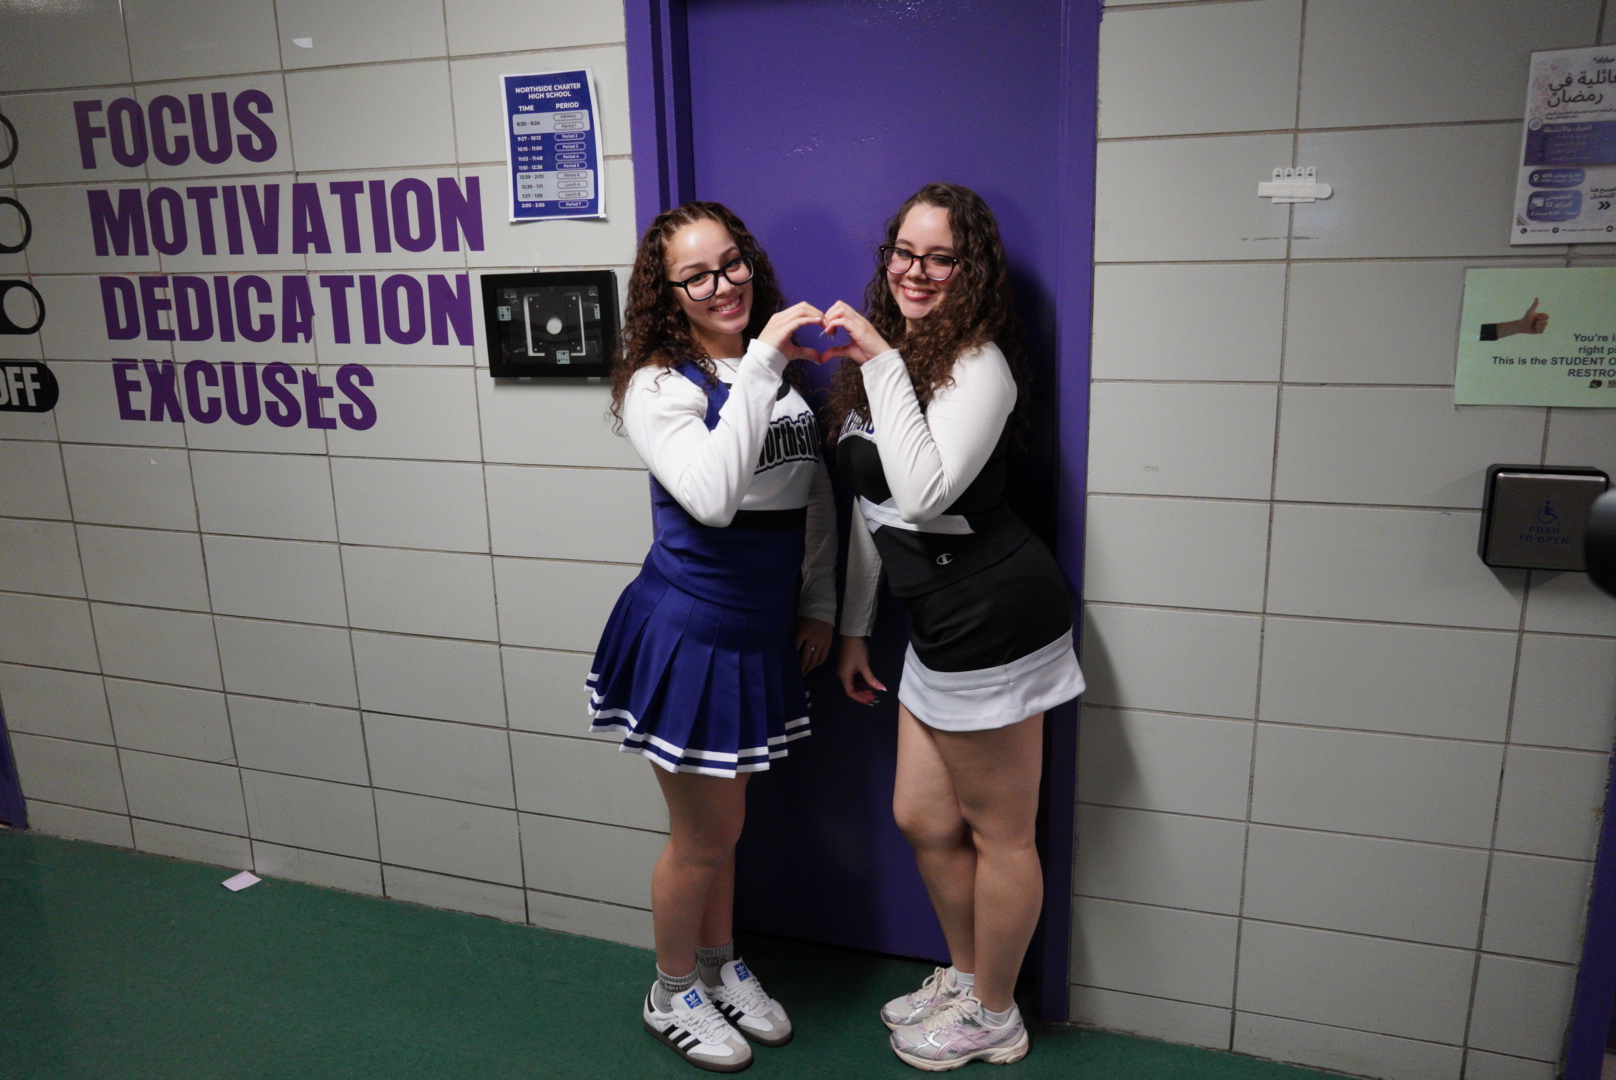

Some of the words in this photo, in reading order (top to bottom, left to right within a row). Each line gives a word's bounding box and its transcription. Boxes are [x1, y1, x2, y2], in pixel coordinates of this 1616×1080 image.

[515, 85, 552, 94] NORTHSIDE
[1548, 89, 1604, 108] رمضان
[73, 89, 278, 169] FOCUS
[86, 176, 485, 256] MOTIVATION
[100, 273, 474, 346] DEDICATION
[1574, 334, 1608, 342] You're
[1578, 346, 1604, 356] right
[1492, 356, 1514, 365] This
[1518, 356, 1527, 365] is
[1530, 357, 1547, 365] the
[1550, 357, 1605, 366] STUDENT
[1568, 369, 1616, 378] RESTRO
[112, 358, 378, 430] EXCUSES
[1528, 525, 1560, 534] PUSH
[1537, 536, 1569, 544] OPEN
